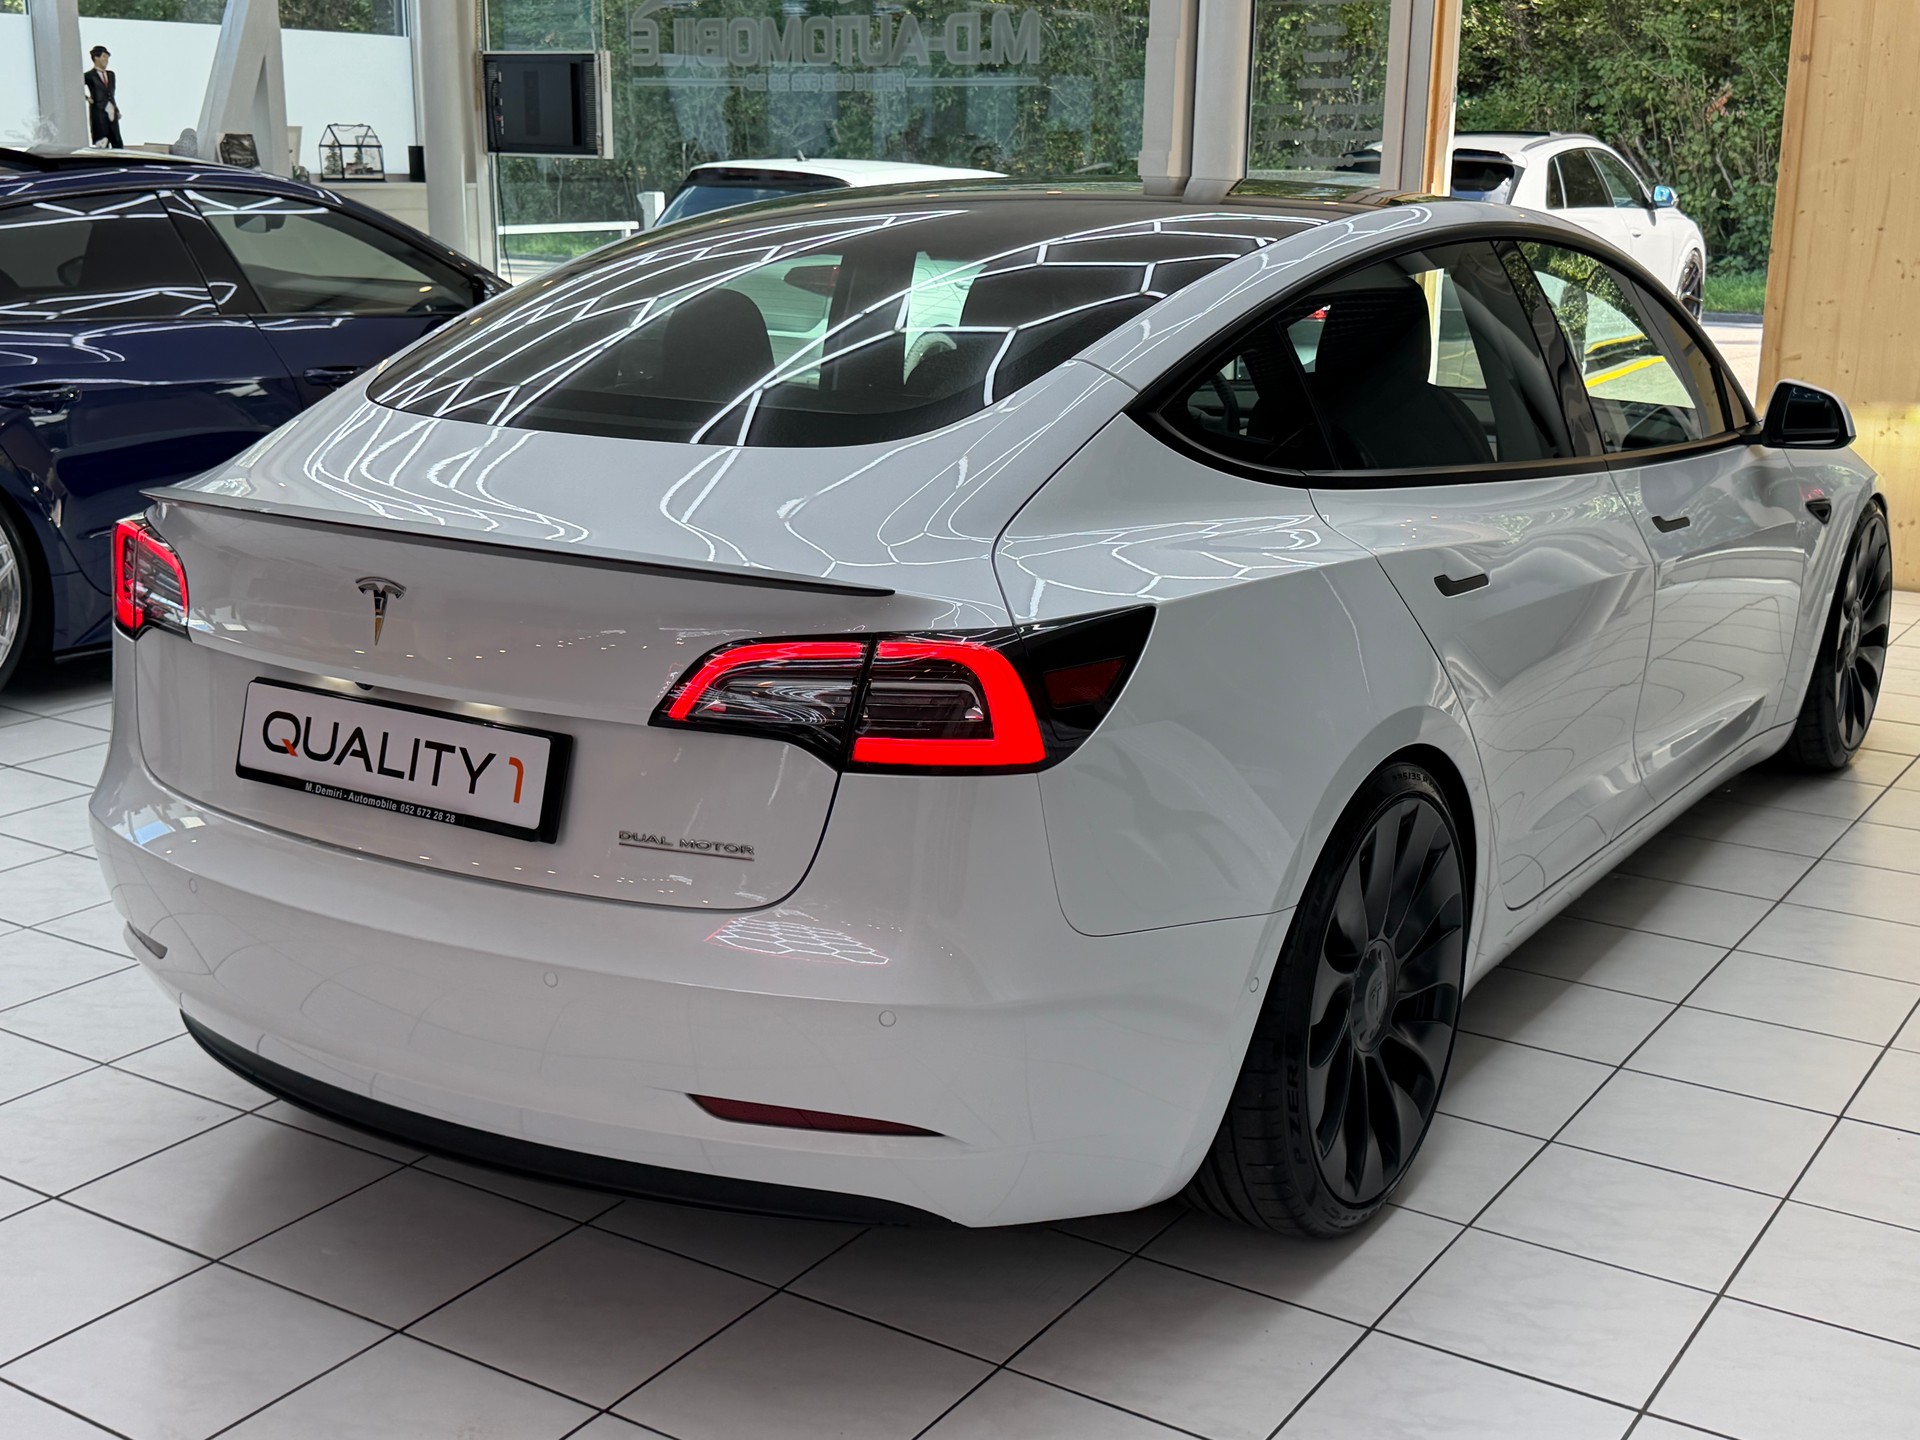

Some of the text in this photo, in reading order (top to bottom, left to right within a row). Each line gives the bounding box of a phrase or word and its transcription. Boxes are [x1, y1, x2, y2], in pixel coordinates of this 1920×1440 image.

[262, 710, 496, 795] QUALITY
[348, 792, 398, 811] Automobile
[400, 803, 415, 815] 052
[416, 807, 431, 818] 672
[433, 810, 443, 821] 28
[445, 812, 456, 824] 28
[618, 830, 755, 856] DUAL MOTOR
